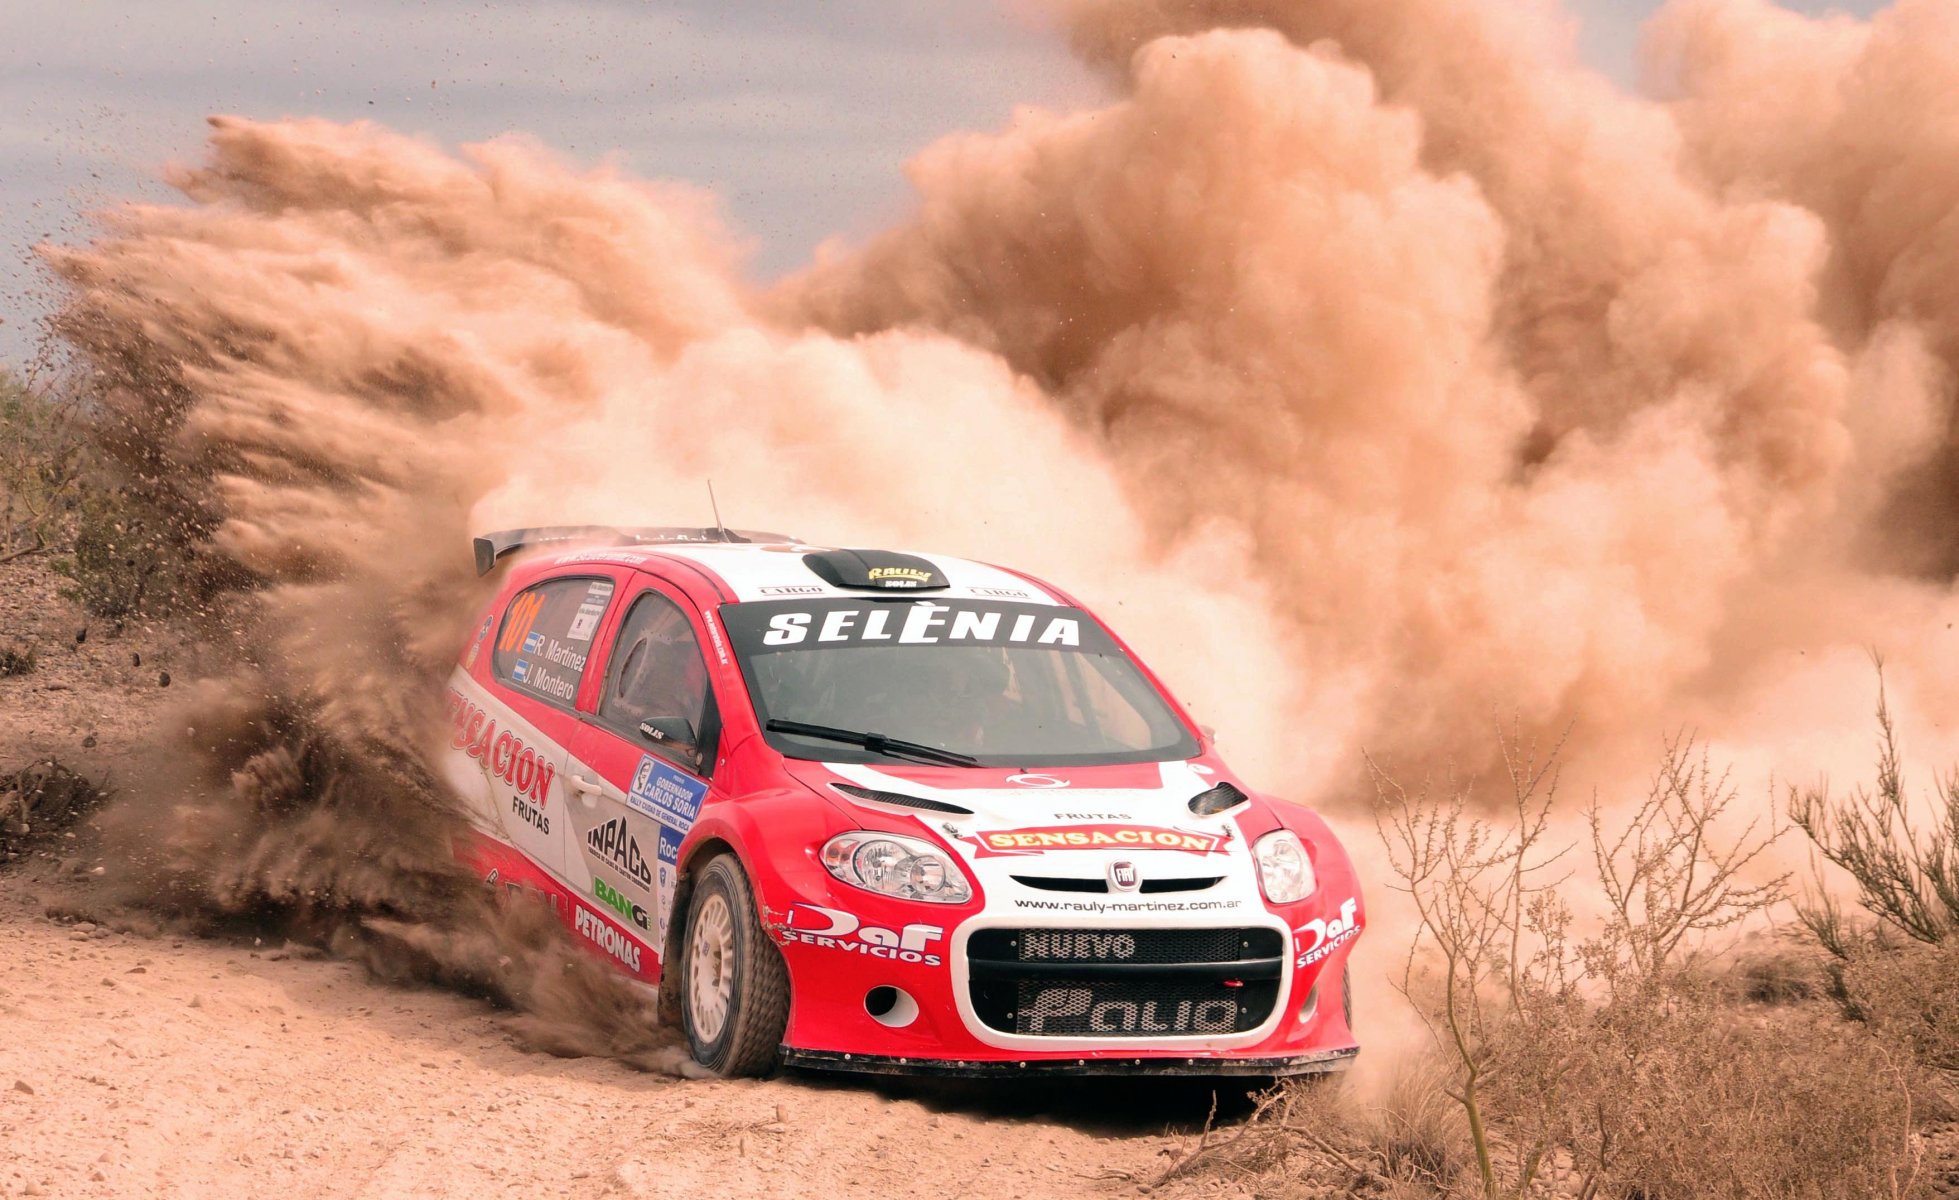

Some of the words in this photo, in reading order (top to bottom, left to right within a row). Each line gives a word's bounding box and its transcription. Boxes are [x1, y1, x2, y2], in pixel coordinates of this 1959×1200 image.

[498, 592, 546, 653] 101
[533, 635, 546, 657] R.
[545, 639, 587, 673] Martinez
[522, 664, 534, 685] J.
[533, 667, 574, 700] Montero
[644, 783, 673, 809] CARLOS
[672, 797, 696, 819] SORIA
[656, 777, 693, 802] GOBERNADOR
[512, 796, 550, 835] FRUTAS
[988, 829, 1209, 850] SENSACION
[1115, 867, 1135, 883] FIAT
[1014, 899, 1242, 914] www.rauly-martinez.com.ar
[574, 904, 641, 972] PETRONAS
[781, 929, 942, 967] SERVICIOS
[1024, 933, 1136, 959] NUEVO
[1296, 924, 1361, 969] SERVICIOS
